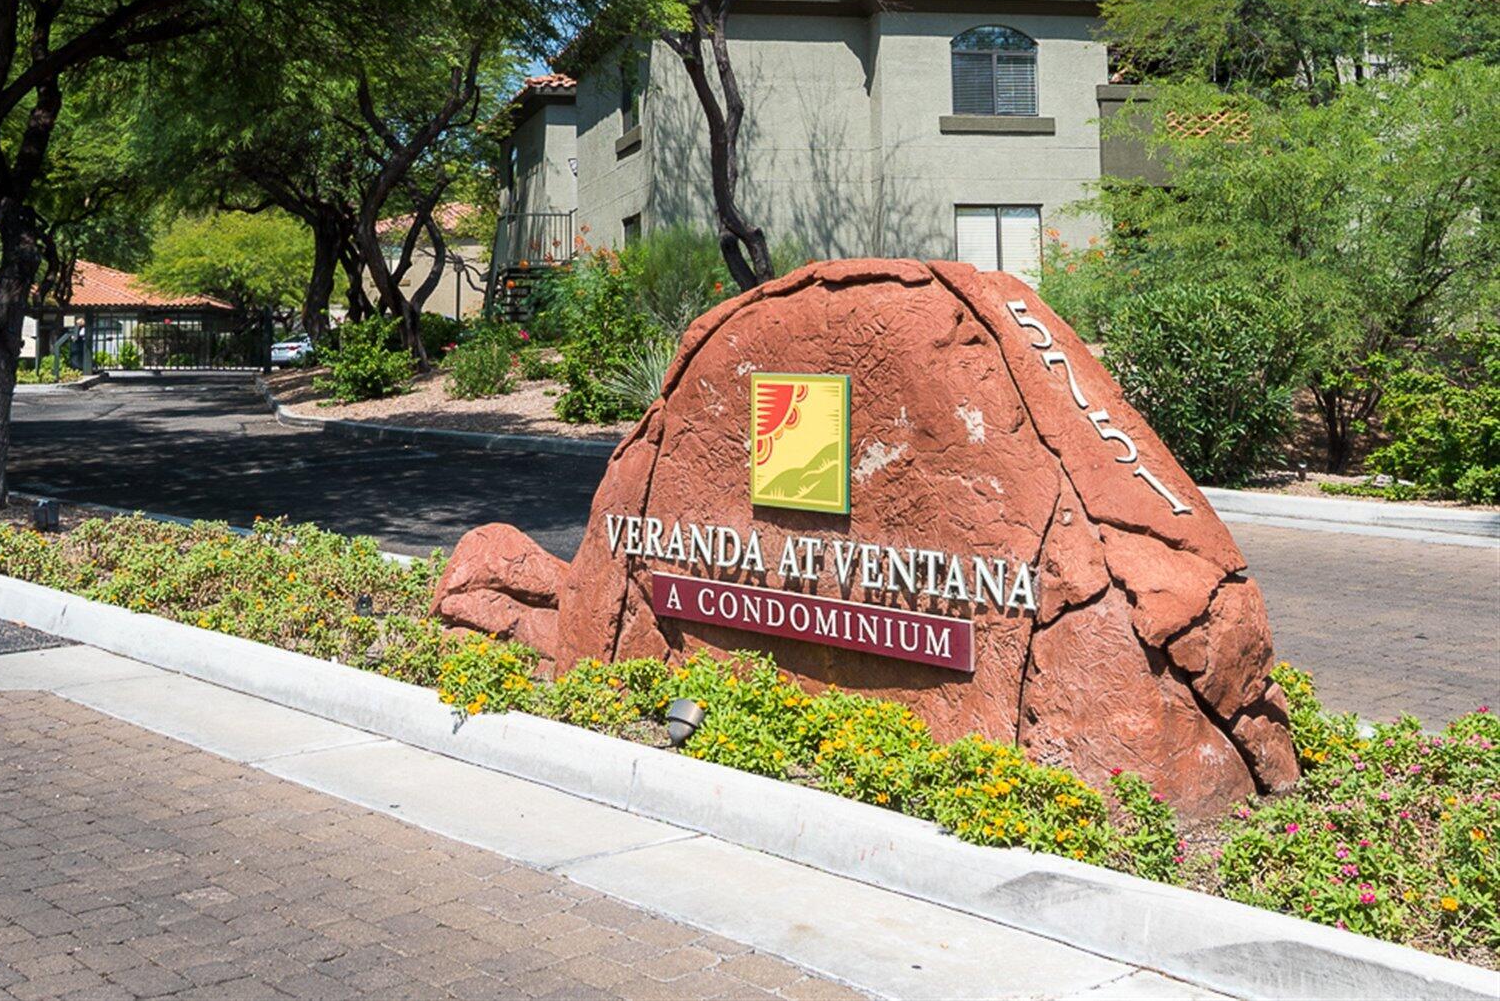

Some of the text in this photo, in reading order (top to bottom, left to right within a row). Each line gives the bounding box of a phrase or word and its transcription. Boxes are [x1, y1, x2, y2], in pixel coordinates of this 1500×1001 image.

[1006, 299, 1192, 515] 5751
[605, 513, 1038, 611] VERANDA AT VENTANA
[666, 583, 953, 659] A CONDOMINIUM
